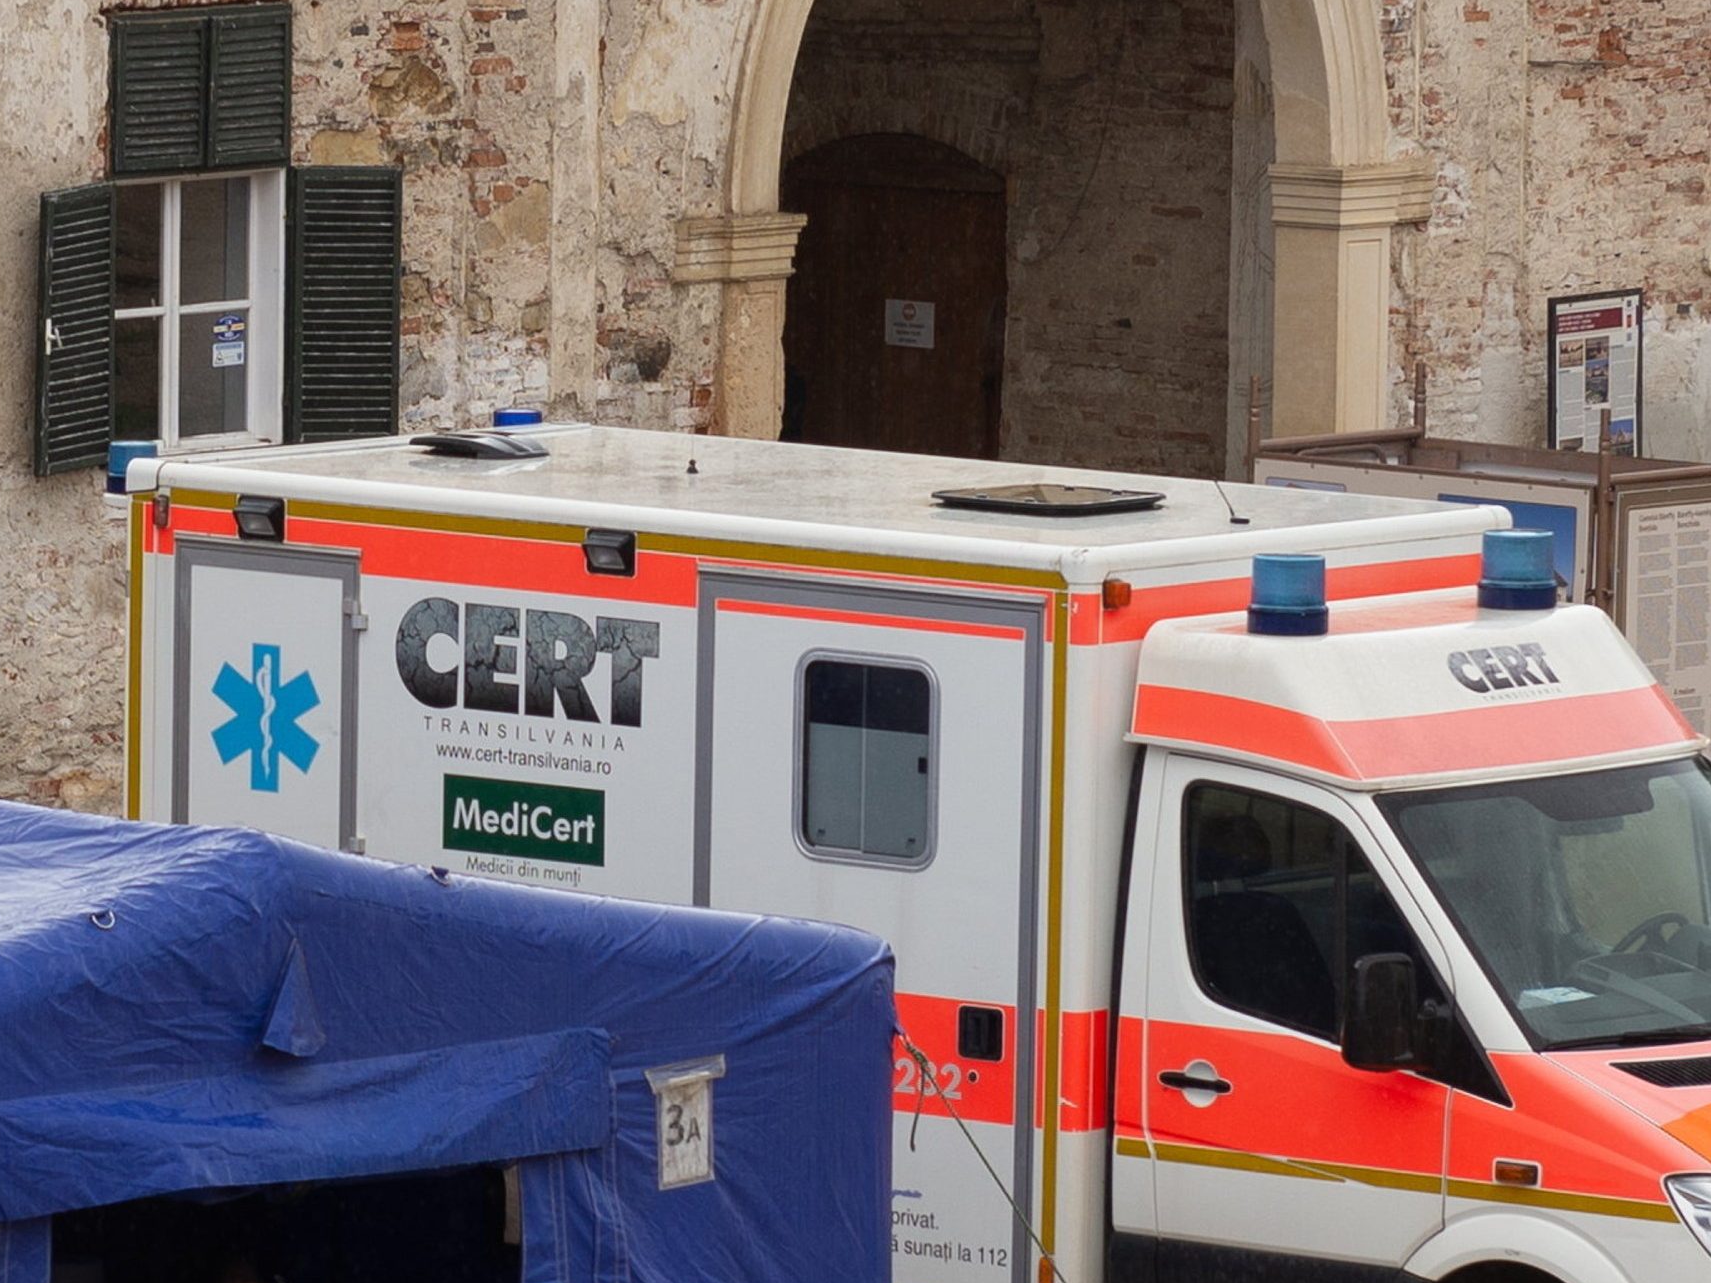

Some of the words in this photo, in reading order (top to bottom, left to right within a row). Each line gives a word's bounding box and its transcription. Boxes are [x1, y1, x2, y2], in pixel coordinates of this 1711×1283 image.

[395, 596, 661, 728] CERT
[1447, 642, 1560, 694] CERT
[424, 716, 625, 752] TRANSILVANIA
[436, 743, 612, 776] www.cert-transilvania.ro
[452, 797, 596, 845] MediCert
[465, 856, 514, 876] Medicii
[517, 861, 539, 879] din
[957, 1242, 973, 1263] la
[977, 1246, 1008, 1268] 112
